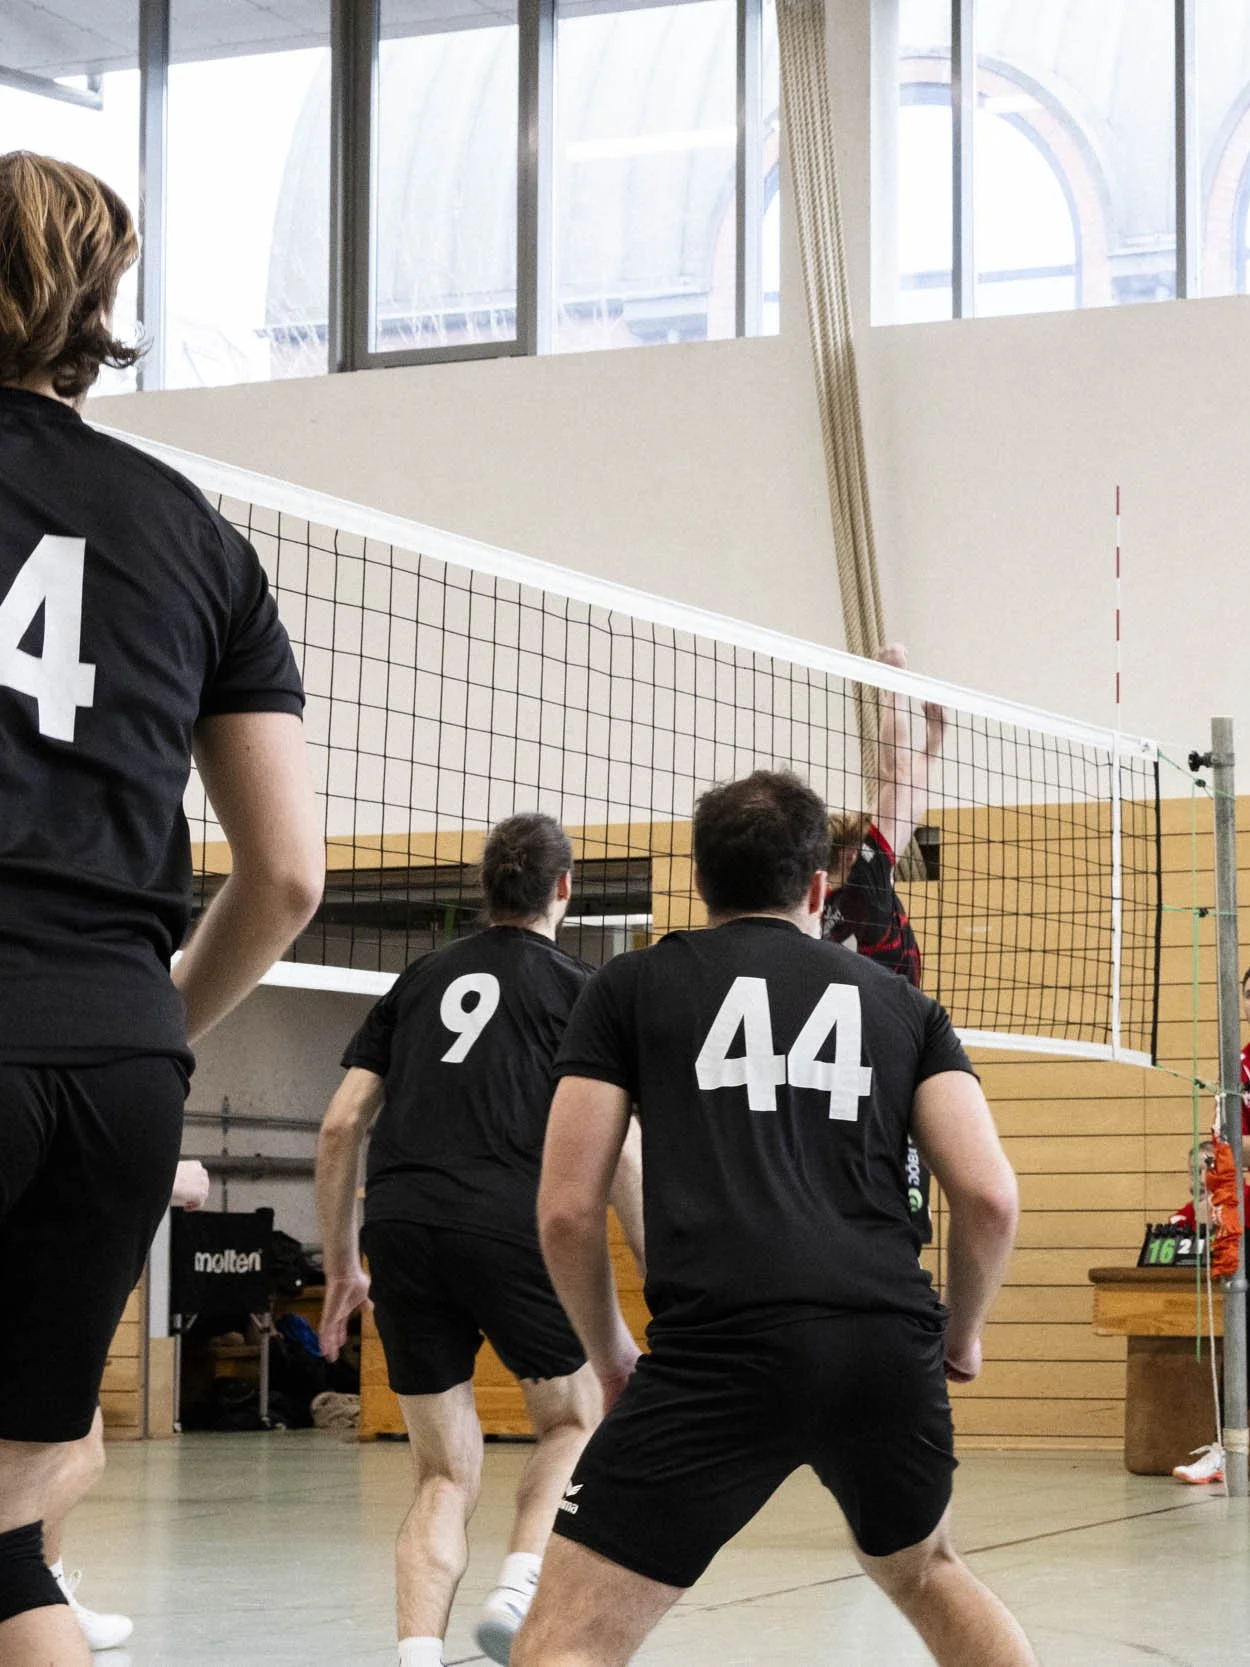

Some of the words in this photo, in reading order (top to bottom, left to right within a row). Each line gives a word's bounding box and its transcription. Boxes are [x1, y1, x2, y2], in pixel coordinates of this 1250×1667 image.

[440, 972, 501, 1063] 9
[695, 976, 872, 1121] 44
[194, 1248, 262, 1274] molten
[1148, 1238, 1176, 1264] 16
